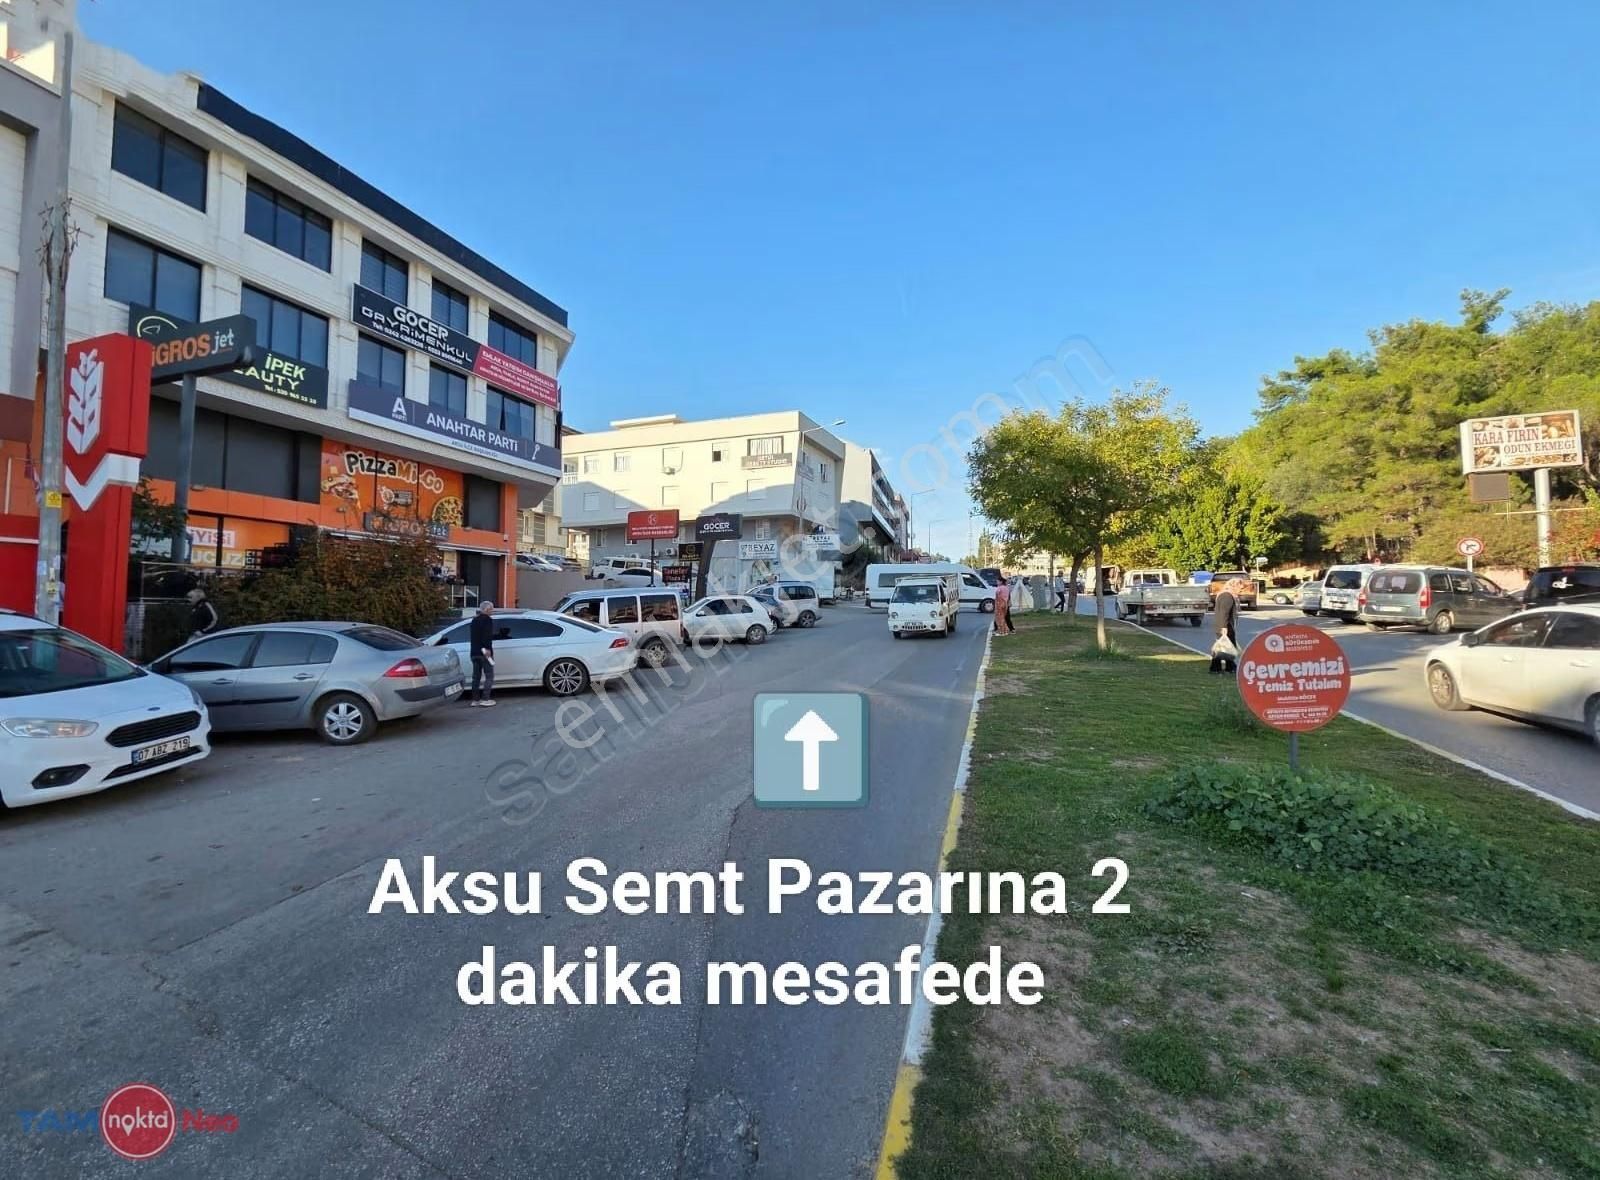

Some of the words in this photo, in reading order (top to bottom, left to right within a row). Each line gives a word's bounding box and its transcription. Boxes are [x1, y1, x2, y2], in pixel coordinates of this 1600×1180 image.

[151, 333, 211, 368] iGROS
[212, 328, 235, 354] jet
[426, 412, 486, 442] ANAHTAR
[1474, 432, 1504, 445] KARA
[1507, 428, 1539, 443] FIRIN
[1504, 444, 1531, 454] ODUN
[1243, 656, 1345, 685] Çevremizi
[1257, 680, 1294, 693] Temiz
[1297, 678, 1342, 691] Tutalım
[138, 749, 150, 761] 07
